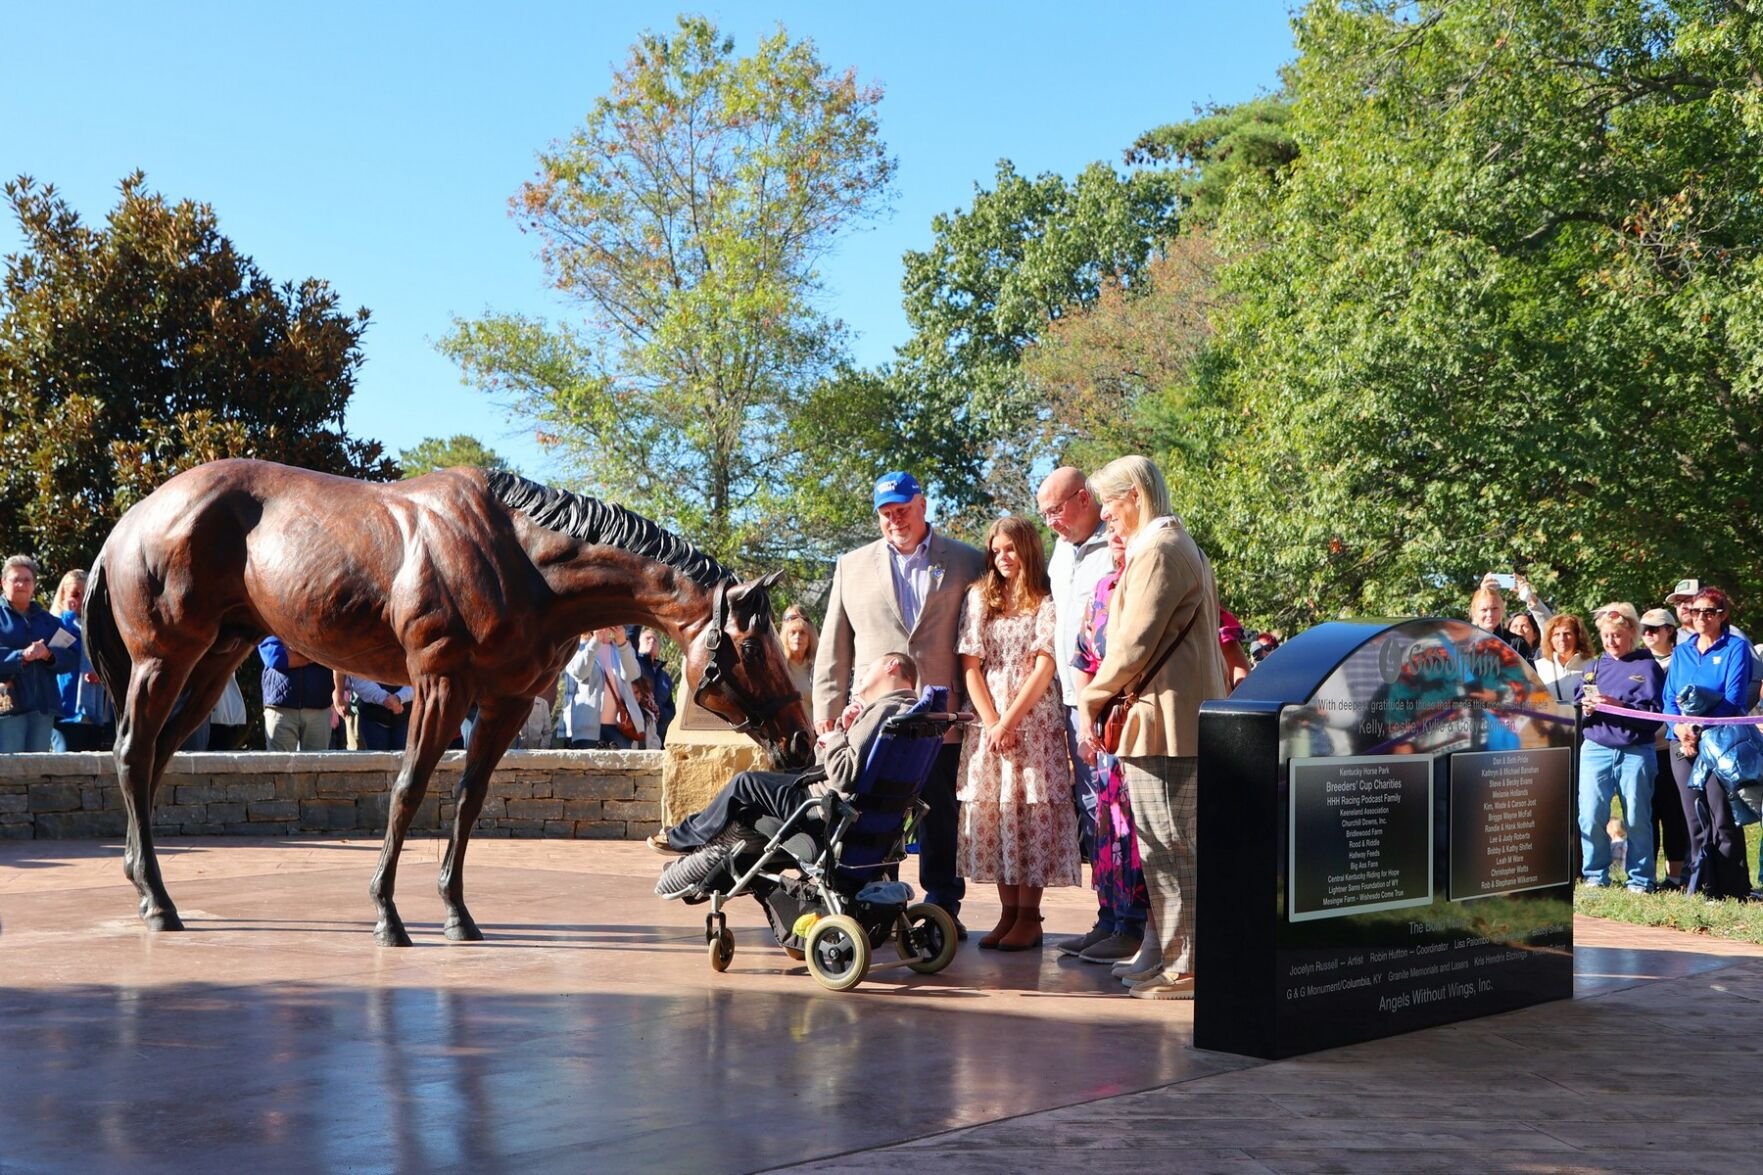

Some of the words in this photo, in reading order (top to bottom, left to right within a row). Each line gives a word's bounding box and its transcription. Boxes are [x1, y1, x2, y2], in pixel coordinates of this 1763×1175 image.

[1318, 699, 1336, 711] With
[1406, 701, 1413, 710] to
[1473, 699, 1485, 709] this
[1359, 719, 1385, 737] Kelly,
[1340, 768, 1362, 776] Kentucky
[1363, 767, 1377, 775] Horse
[1379, 766, 1389, 774] Park
[1359, 780, 1372, 791] Cup
[1374, 778, 1401, 790] Charities
[1327, 796, 1340, 806] HHH
[1341, 796, 1360, 806] Racing
[1361, 794, 1383, 804] Podcast
[1384, 793, 1401, 803] Family
[1511, 800, 1527, 808] Carson
[1340, 808, 1363, 816] Keeneland
[1364, 807, 1389, 815] Association
[1342, 818, 1361, 827] Churchill
[1346, 829, 1370, 837] Bridlewood
[1503, 834, 1513, 842] Judy
[1366, 839, 1380, 847] Riddle
[1487, 847, 1501, 855] Bobby
[1350, 862, 1358, 870] Big
[1328, 874, 1344, 883] Central
[1345, 872, 1365, 881] Kentucky
[1366, 871, 1380, 879] Riding
[1491, 868, 1516, 877] Christopher
[1361, 881, 1385, 890] Foundation
[1481, 881, 1490, 889] Rob
[1517, 875, 1538, 884] Wilkerson
[1409, 921, 1423, 934] The
[1290, 963, 1314, 976] Jocelyn
[1316, 959, 1338, 972] Russell
[1347, 955, 1363, 966] Artist
[1370, 951, 1387, 962] Robin
[1389, 949, 1408, 959] Hutton
[1416, 942, 1449, 955] Coordinator
[1454, 940, 1465, 949] Lisa
[1467, 936, 1489, 947] Palombo
[1287, 989, 1292, 1000] G
[1300, 986, 1305, 997] G
[1373, 974, 1382, 984] KY
[1388, 967, 1409, 981] Granite
[1411, 962, 1439, 976] Memorials
[1440, 964, 1450, 972] and
[1451, 960, 1469, 970] Lasers
[1474, 957, 1484, 967] Kris
[1379, 992, 1410, 1013] Angels
[1412, 986, 1446, 1004] Without
[1448, 981, 1476, 998] Wings,
[1479, 978, 1493, 992] Inc.
